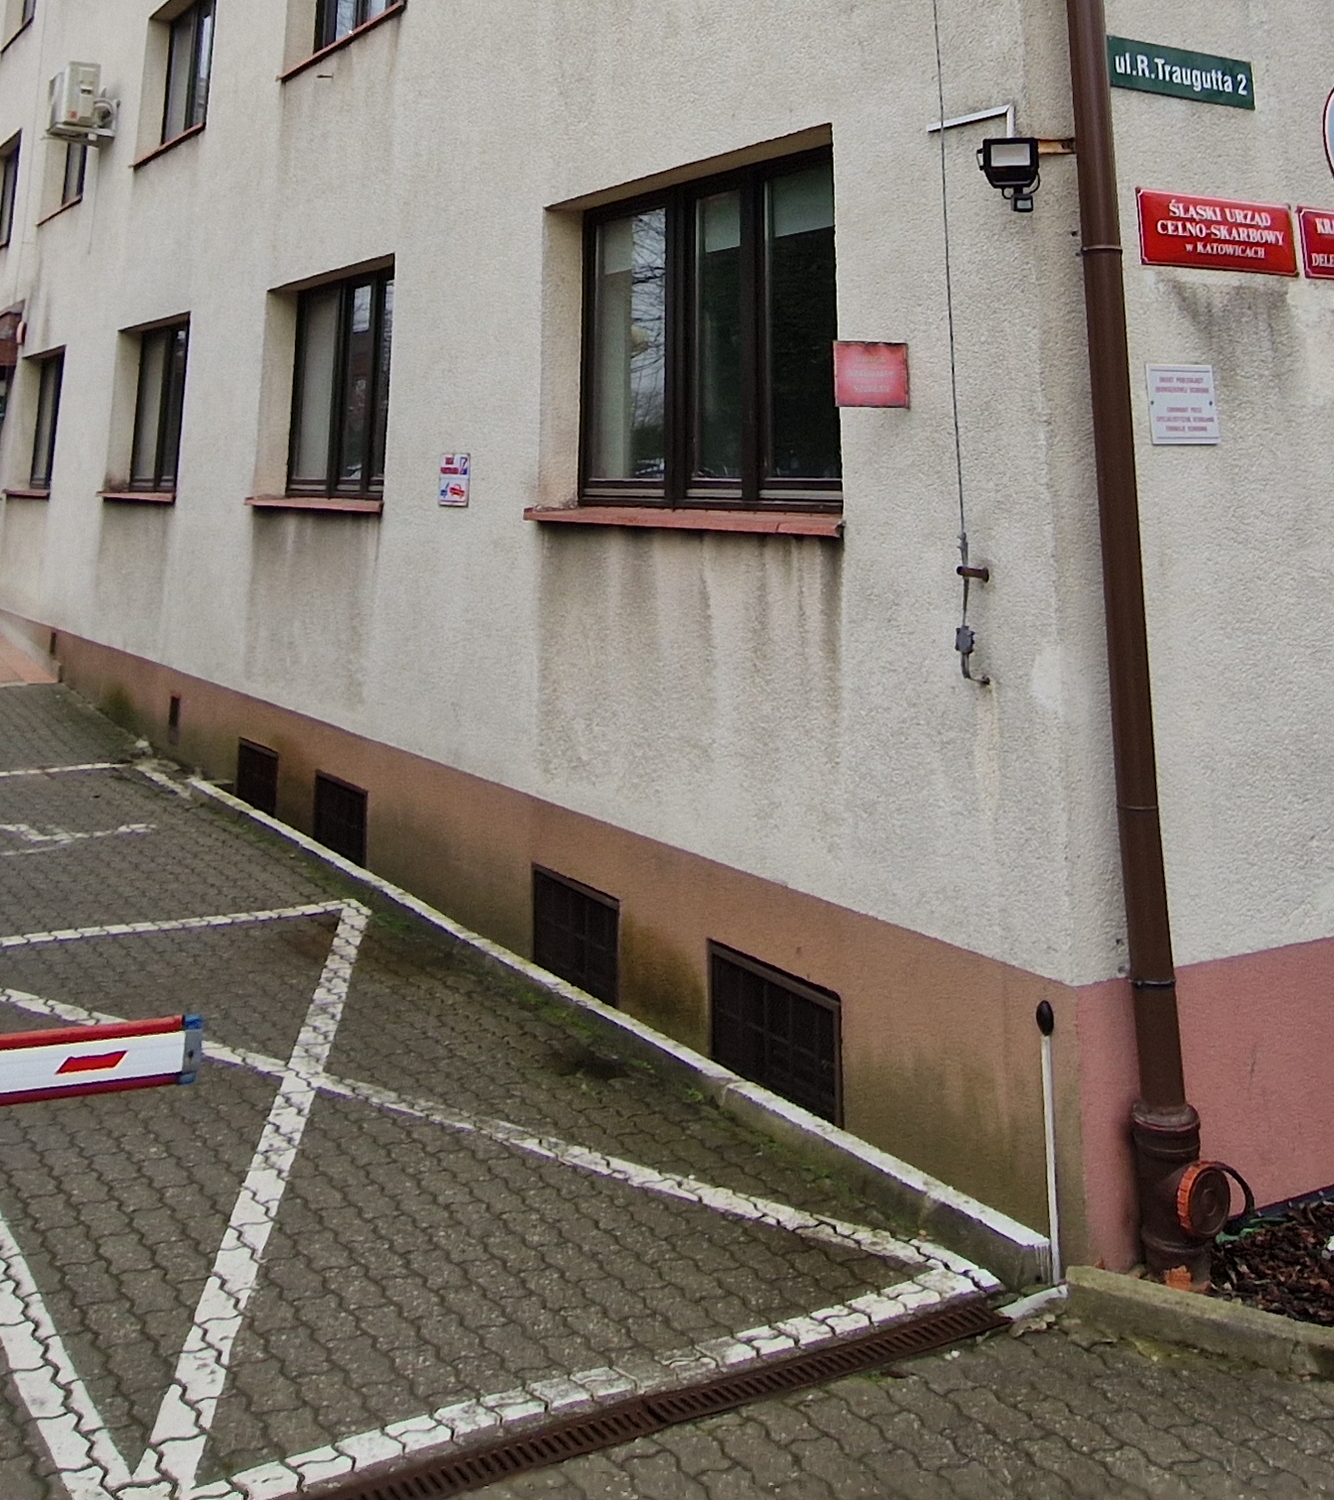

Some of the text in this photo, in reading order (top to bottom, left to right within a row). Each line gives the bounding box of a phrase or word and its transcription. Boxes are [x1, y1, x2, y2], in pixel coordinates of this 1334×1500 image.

[1237, 73, 1248, 96] 2
[1168, 199, 1271, 228] ŚLĄSKI URZĄD
[1157, 219, 1284, 246] CELNO-SKARBOWY
[1196, 241, 1265, 259] KATOWICACH
